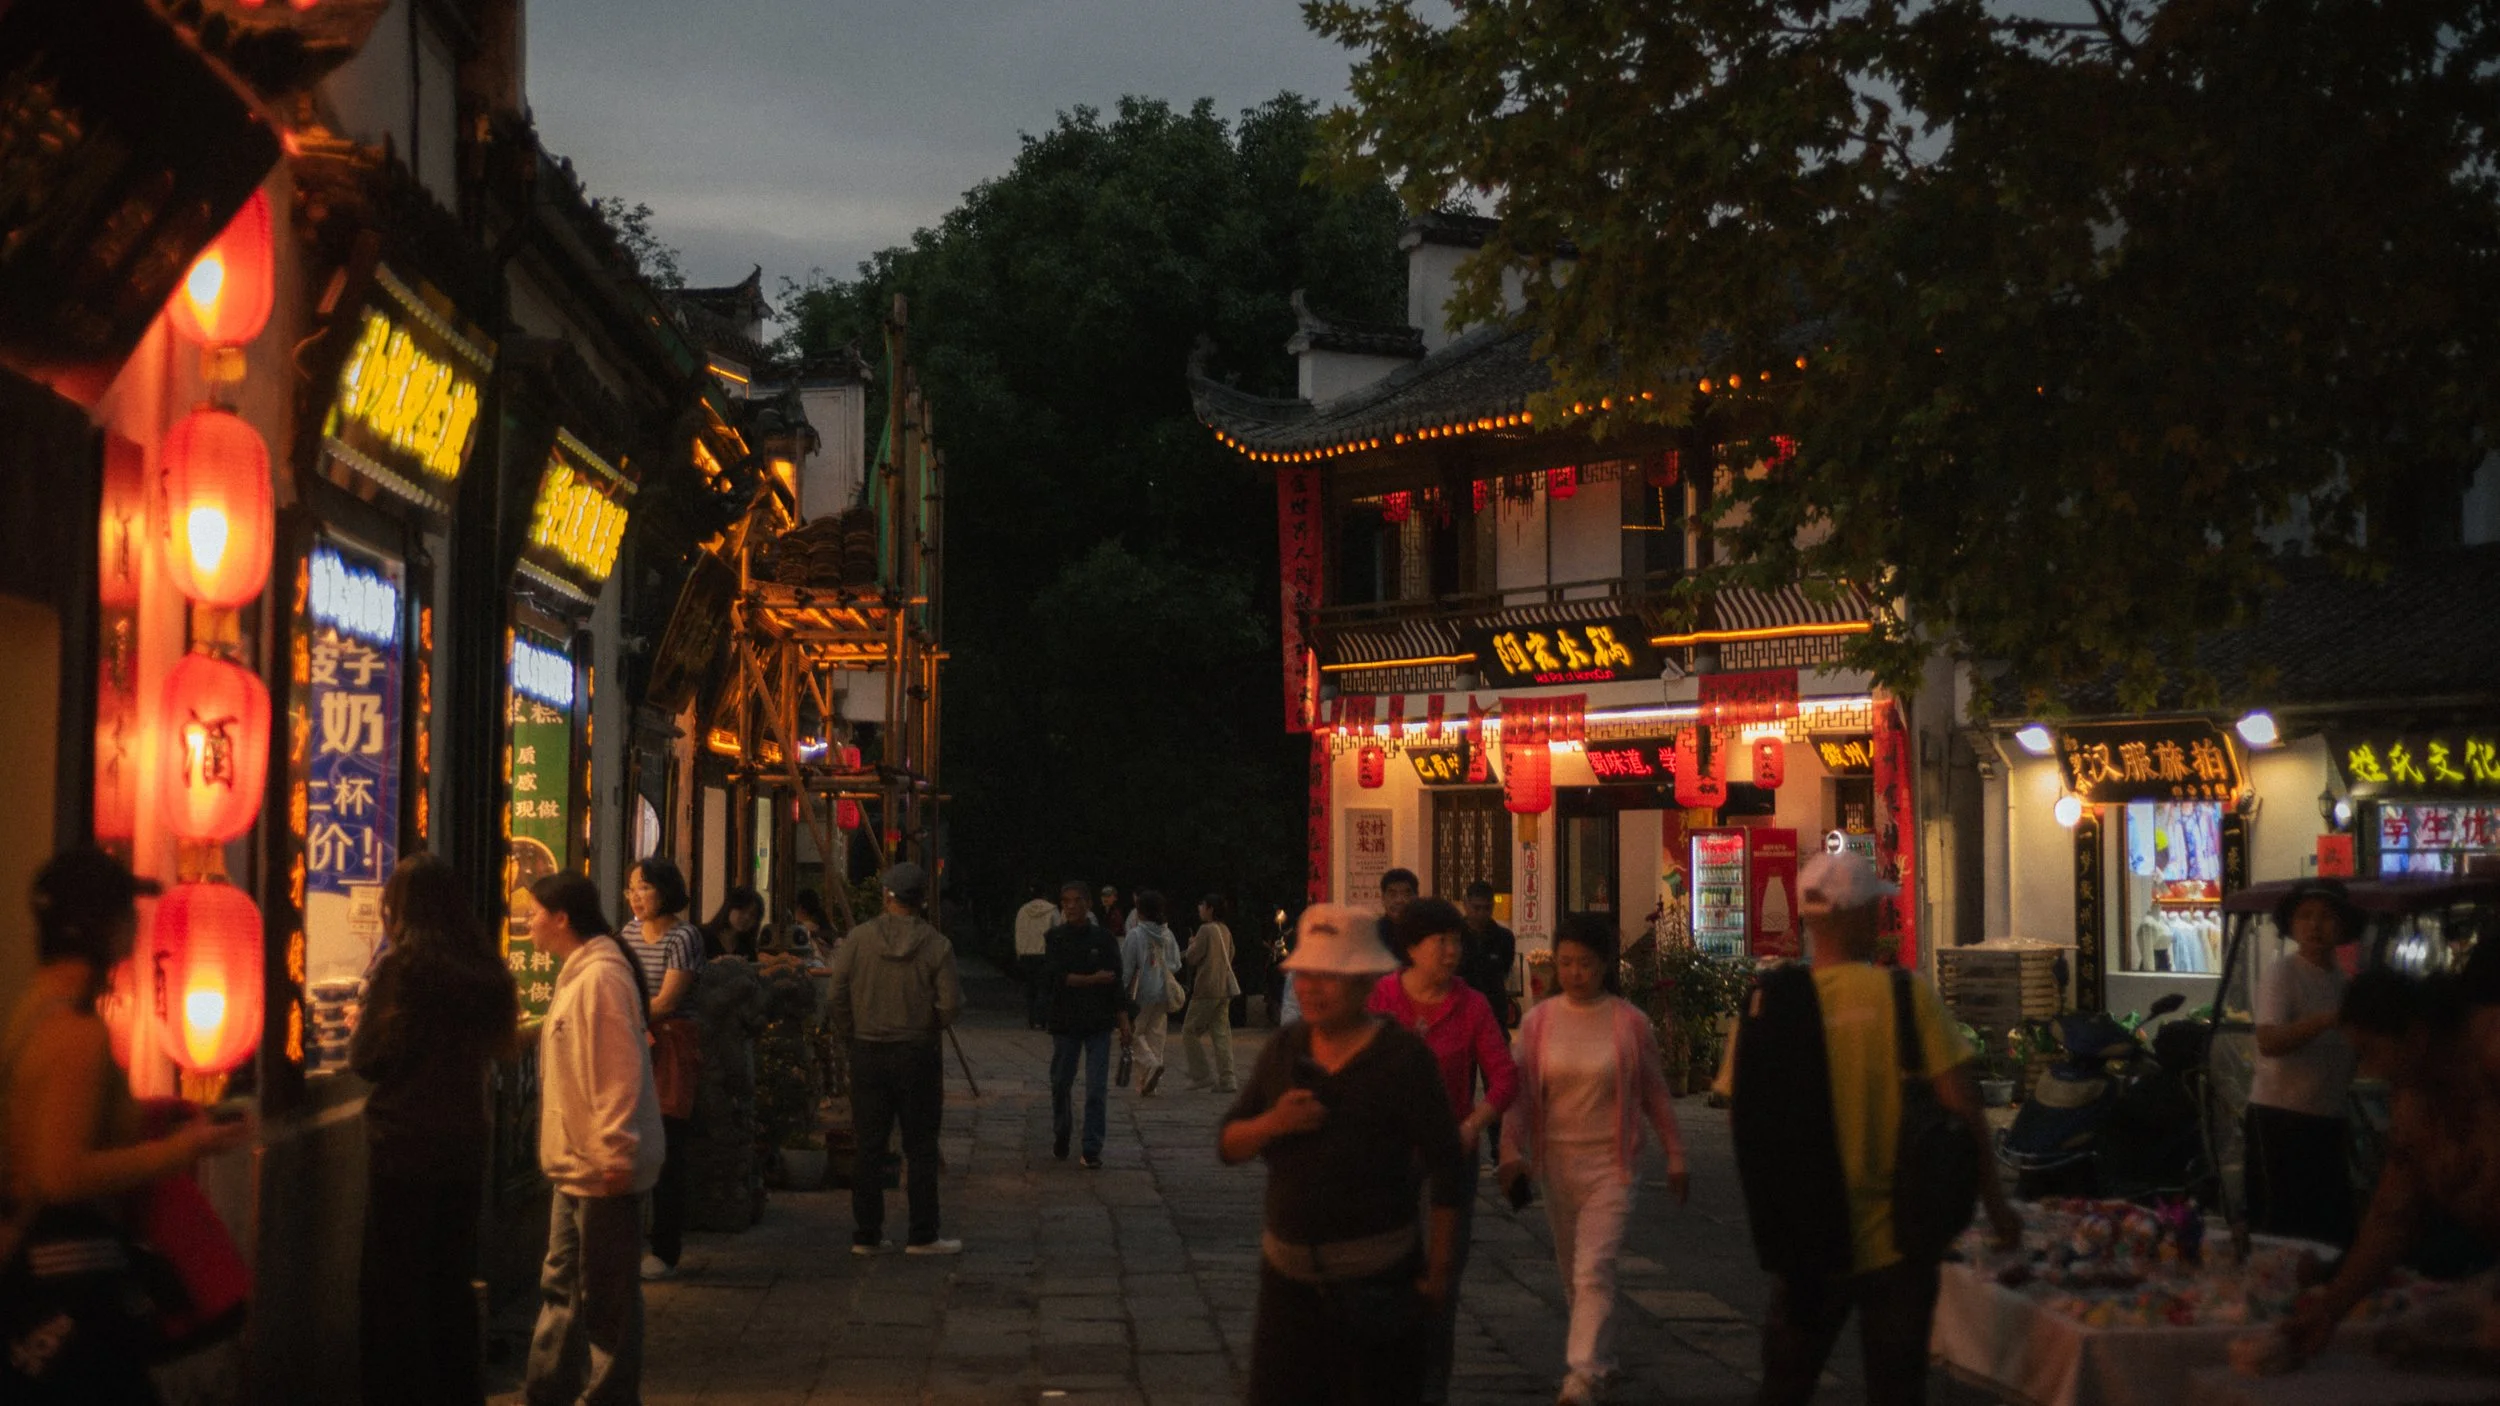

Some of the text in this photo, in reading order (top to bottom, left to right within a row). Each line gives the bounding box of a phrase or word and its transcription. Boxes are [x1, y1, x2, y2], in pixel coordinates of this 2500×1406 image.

[180, 709, 240, 789] 酒
[320, 691, 385, 754] 奶
[1820, 739, 1875, 767] 徽州
